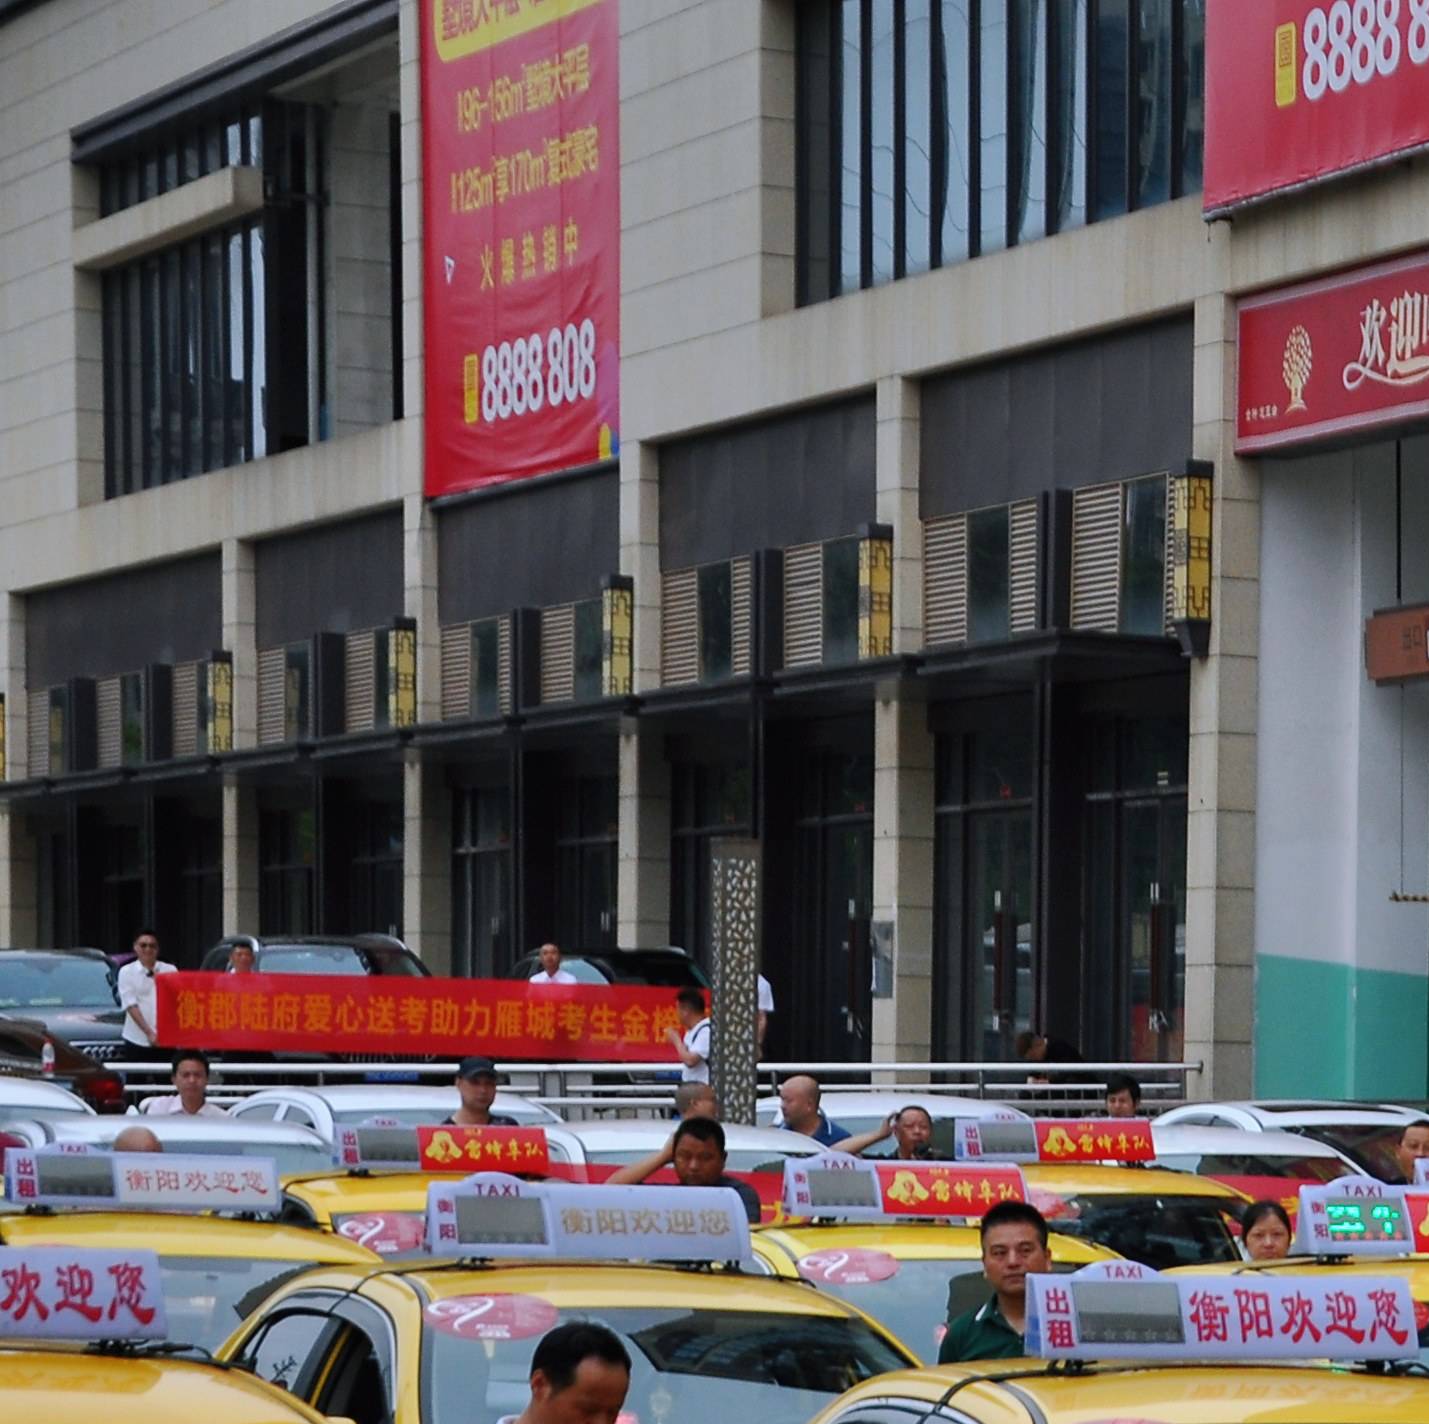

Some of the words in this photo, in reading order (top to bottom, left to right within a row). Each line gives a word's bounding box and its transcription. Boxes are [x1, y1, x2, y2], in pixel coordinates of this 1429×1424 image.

[481, 333, 544, 422] 8888
[547, 318, 596, 407] 808
[125, 1168, 269, 1196] 衡阳欢迎您
[474, 1183, 521, 1198] TAXI
[1341, 1183, 1384, 1199] TAXI
[560, 1206, 733, 1238] 衡阳欢迎您
[1103, 1263, 1145, 1280] TAXI
[0, 1262, 156, 1324] 欢迎您
[1045, 1287, 1076, 1349] 出租
[1189, 1287, 1409, 1347] 衡阳欢迎您
